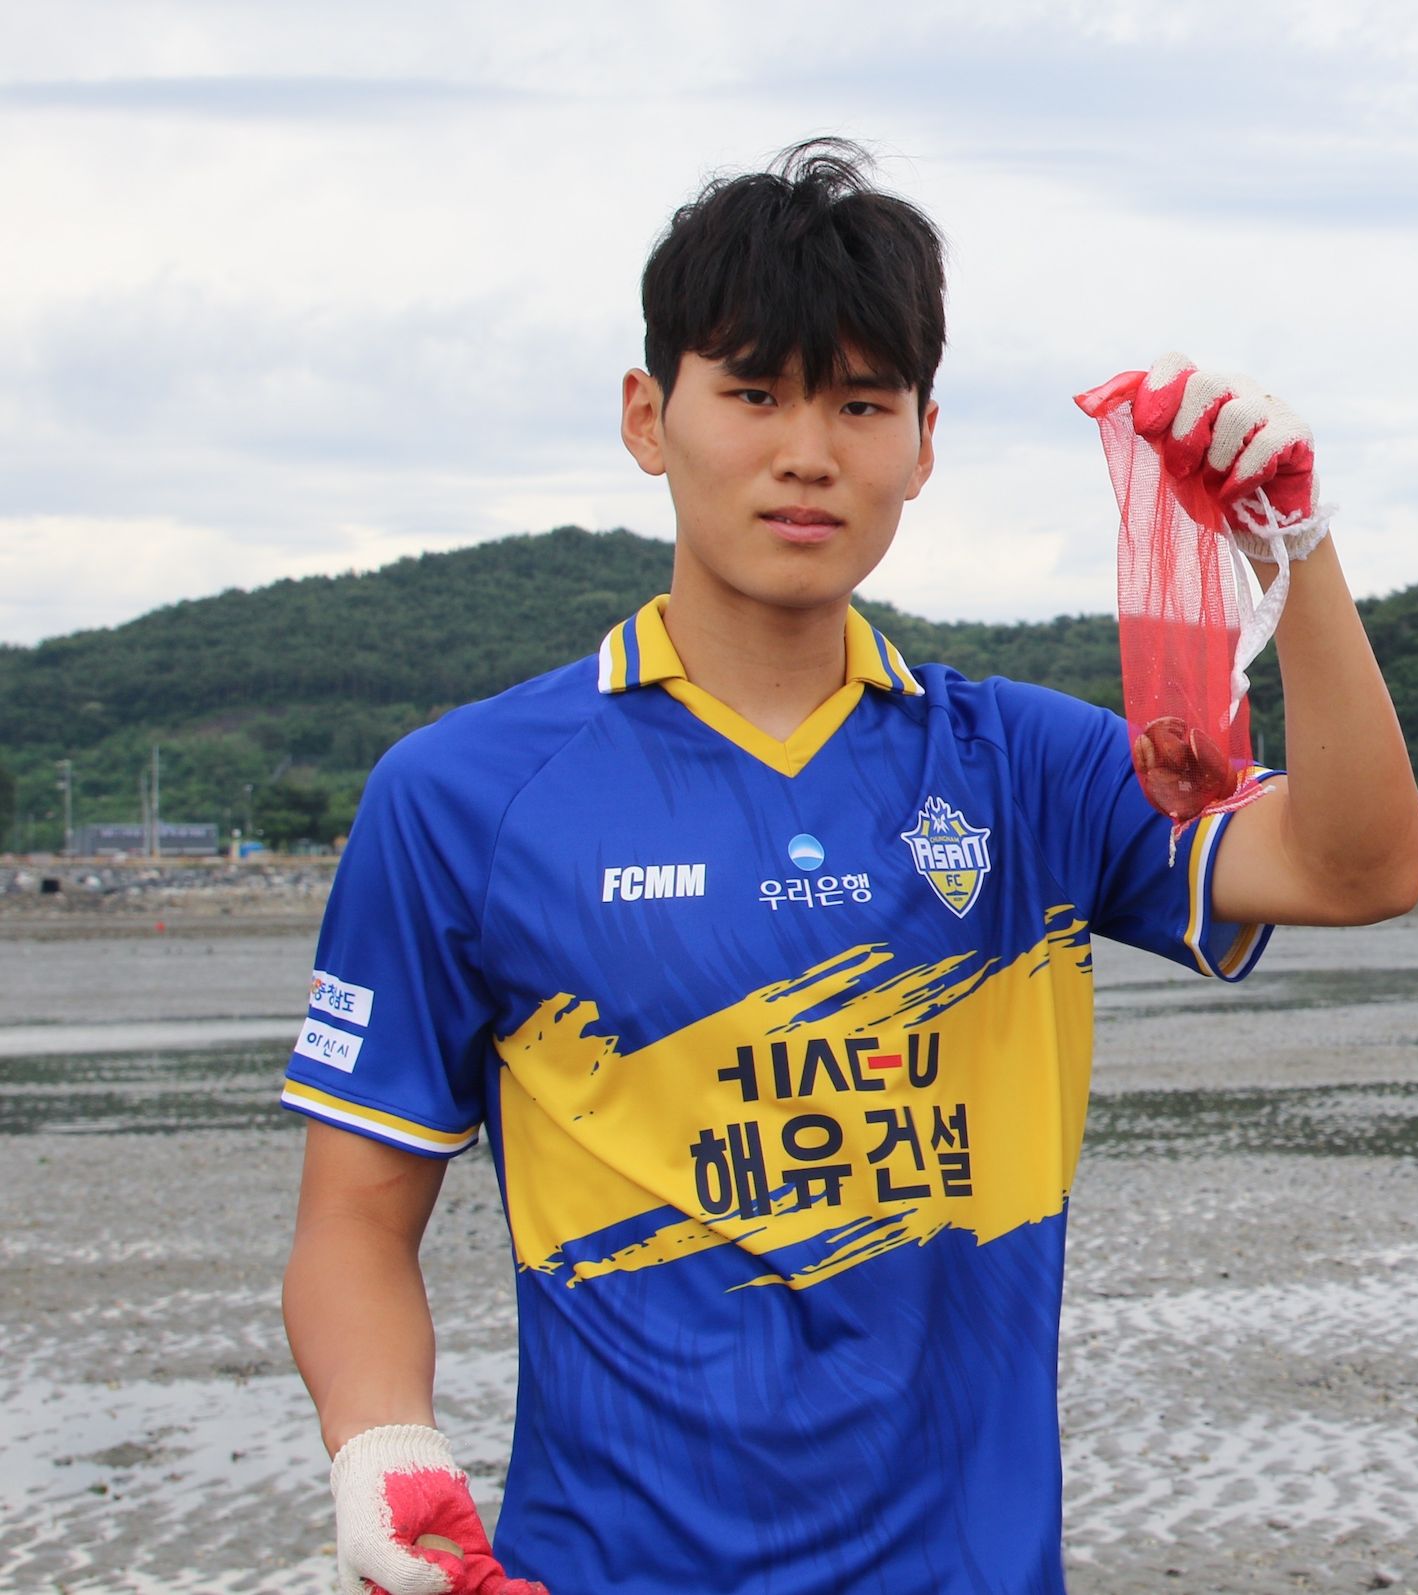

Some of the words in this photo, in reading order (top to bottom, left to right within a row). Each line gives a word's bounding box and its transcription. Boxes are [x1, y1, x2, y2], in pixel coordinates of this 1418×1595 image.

[912, 836, 985, 870] ASAN
[602, 863, 706, 902] FCMM
[758, 873, 873, 910] 우리은행
[945, 874, 963, 888] FC
[690, 1103, 973, 1221] 해유건설
